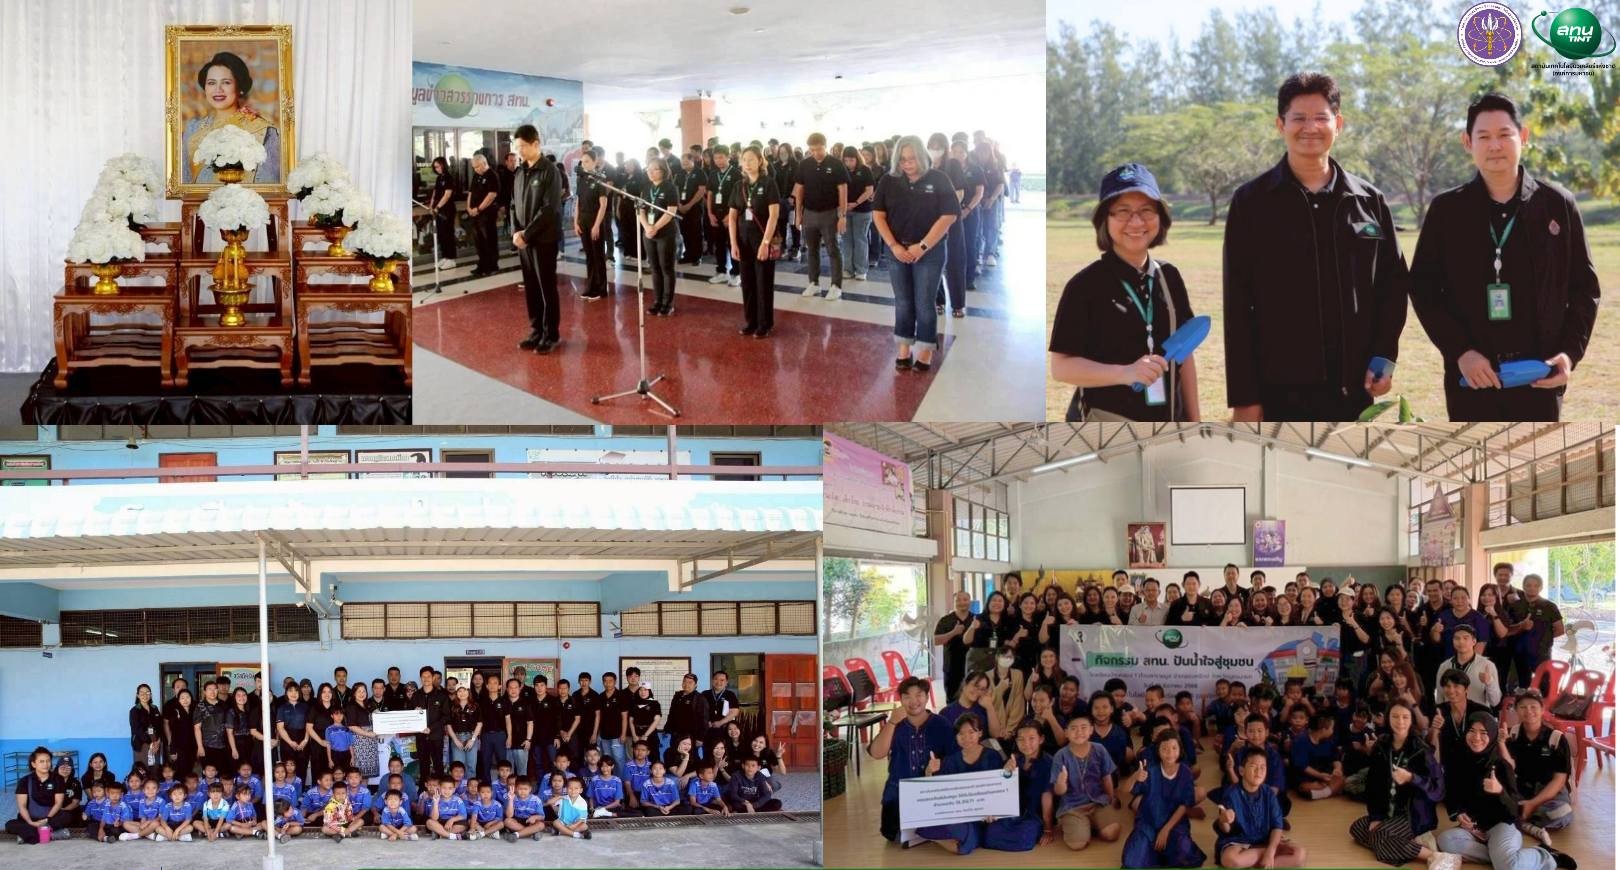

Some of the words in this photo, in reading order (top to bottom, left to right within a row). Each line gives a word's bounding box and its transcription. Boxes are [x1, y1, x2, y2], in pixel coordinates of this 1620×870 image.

[1094, 652, 1138, 667] กิจกรรม
[1143, 657, 1169, 667] สทน.
[1173, 651, 1254, 669] ปันน้ำใจสู่ชุมชน
